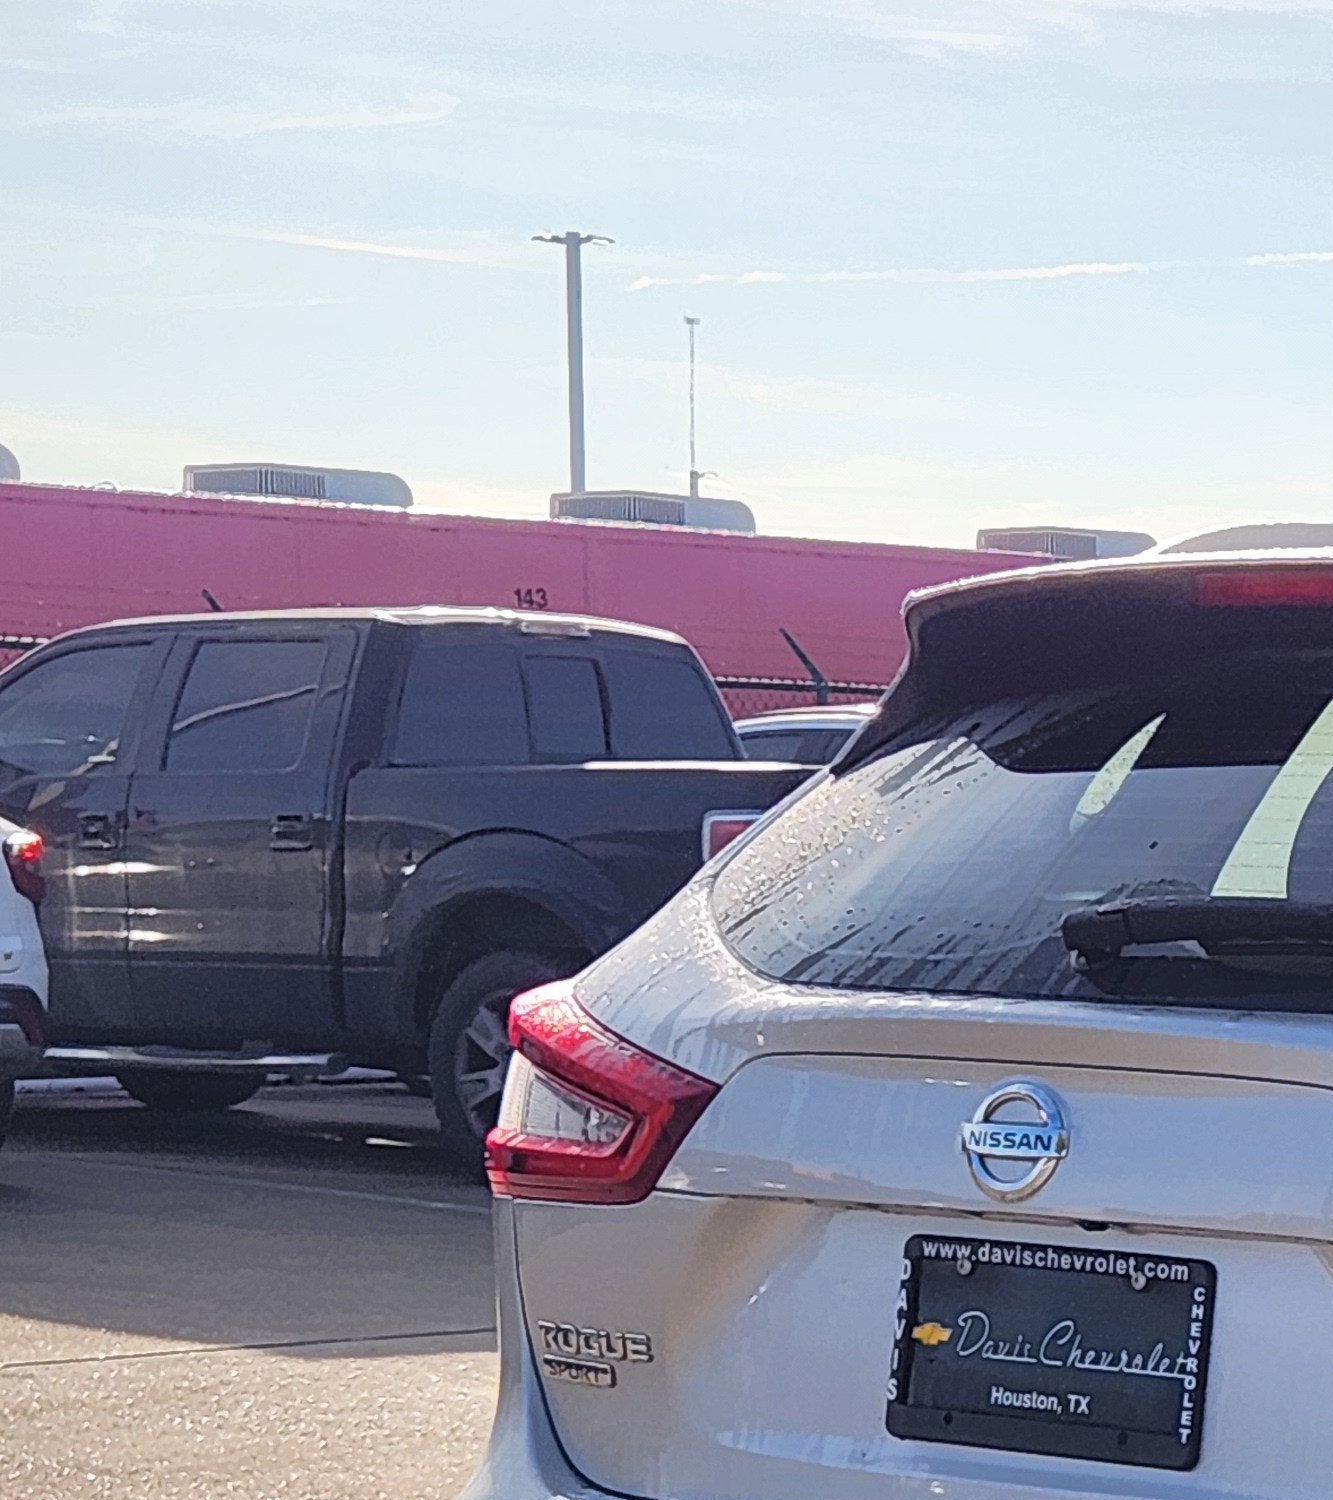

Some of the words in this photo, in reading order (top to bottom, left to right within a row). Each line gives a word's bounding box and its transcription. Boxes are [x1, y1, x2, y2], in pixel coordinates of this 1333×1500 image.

[513, 588, 548, 609] 143
[968, 1130, 1052, 1151] NISSAN
[922, 1241, 1190, 1282] www.davischevrolet.com
[537, 1319, 654, 1363] ROGUE
[956, 1311, 1038, 1364] Davis
[549, 1362, 602, 1383] SPORT
[1178, 1286, 1206, 1445] CHEVROLET
[991, 1386, 1062, 1415] Houston,
[1067, 1394, 1091, 1415] TX
